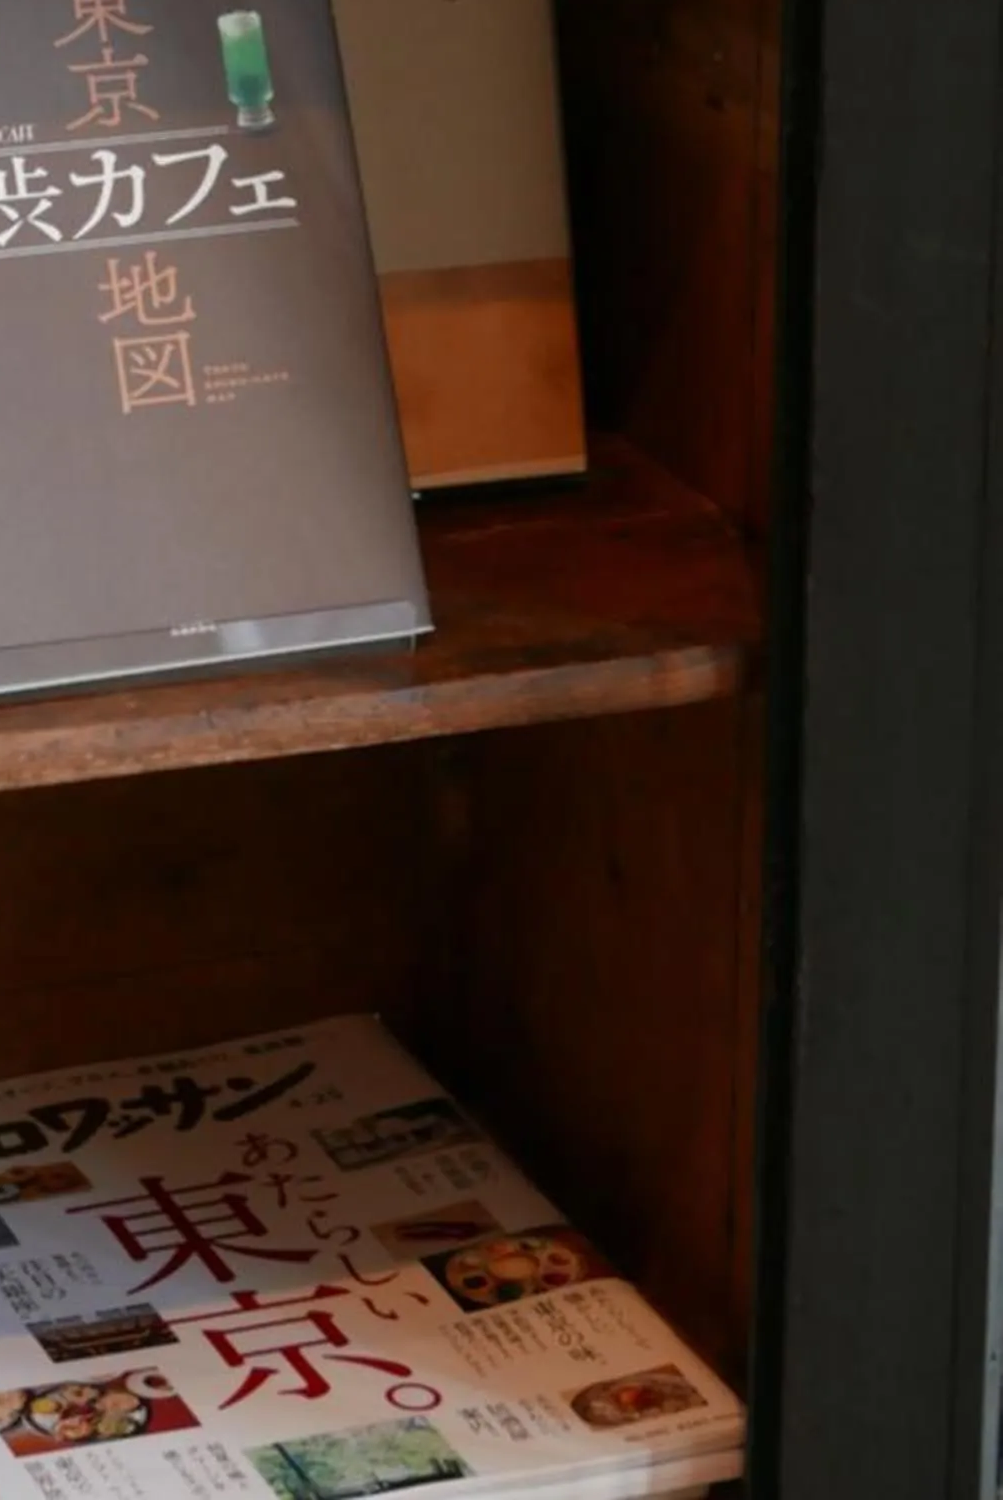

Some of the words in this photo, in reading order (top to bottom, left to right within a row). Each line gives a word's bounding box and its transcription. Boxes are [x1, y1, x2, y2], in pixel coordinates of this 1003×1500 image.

[97, 250, 196, 414] 地図
[63, 1172, 443, 1414] 東京。
[234, 1130, 431, 1322] あたらしい
